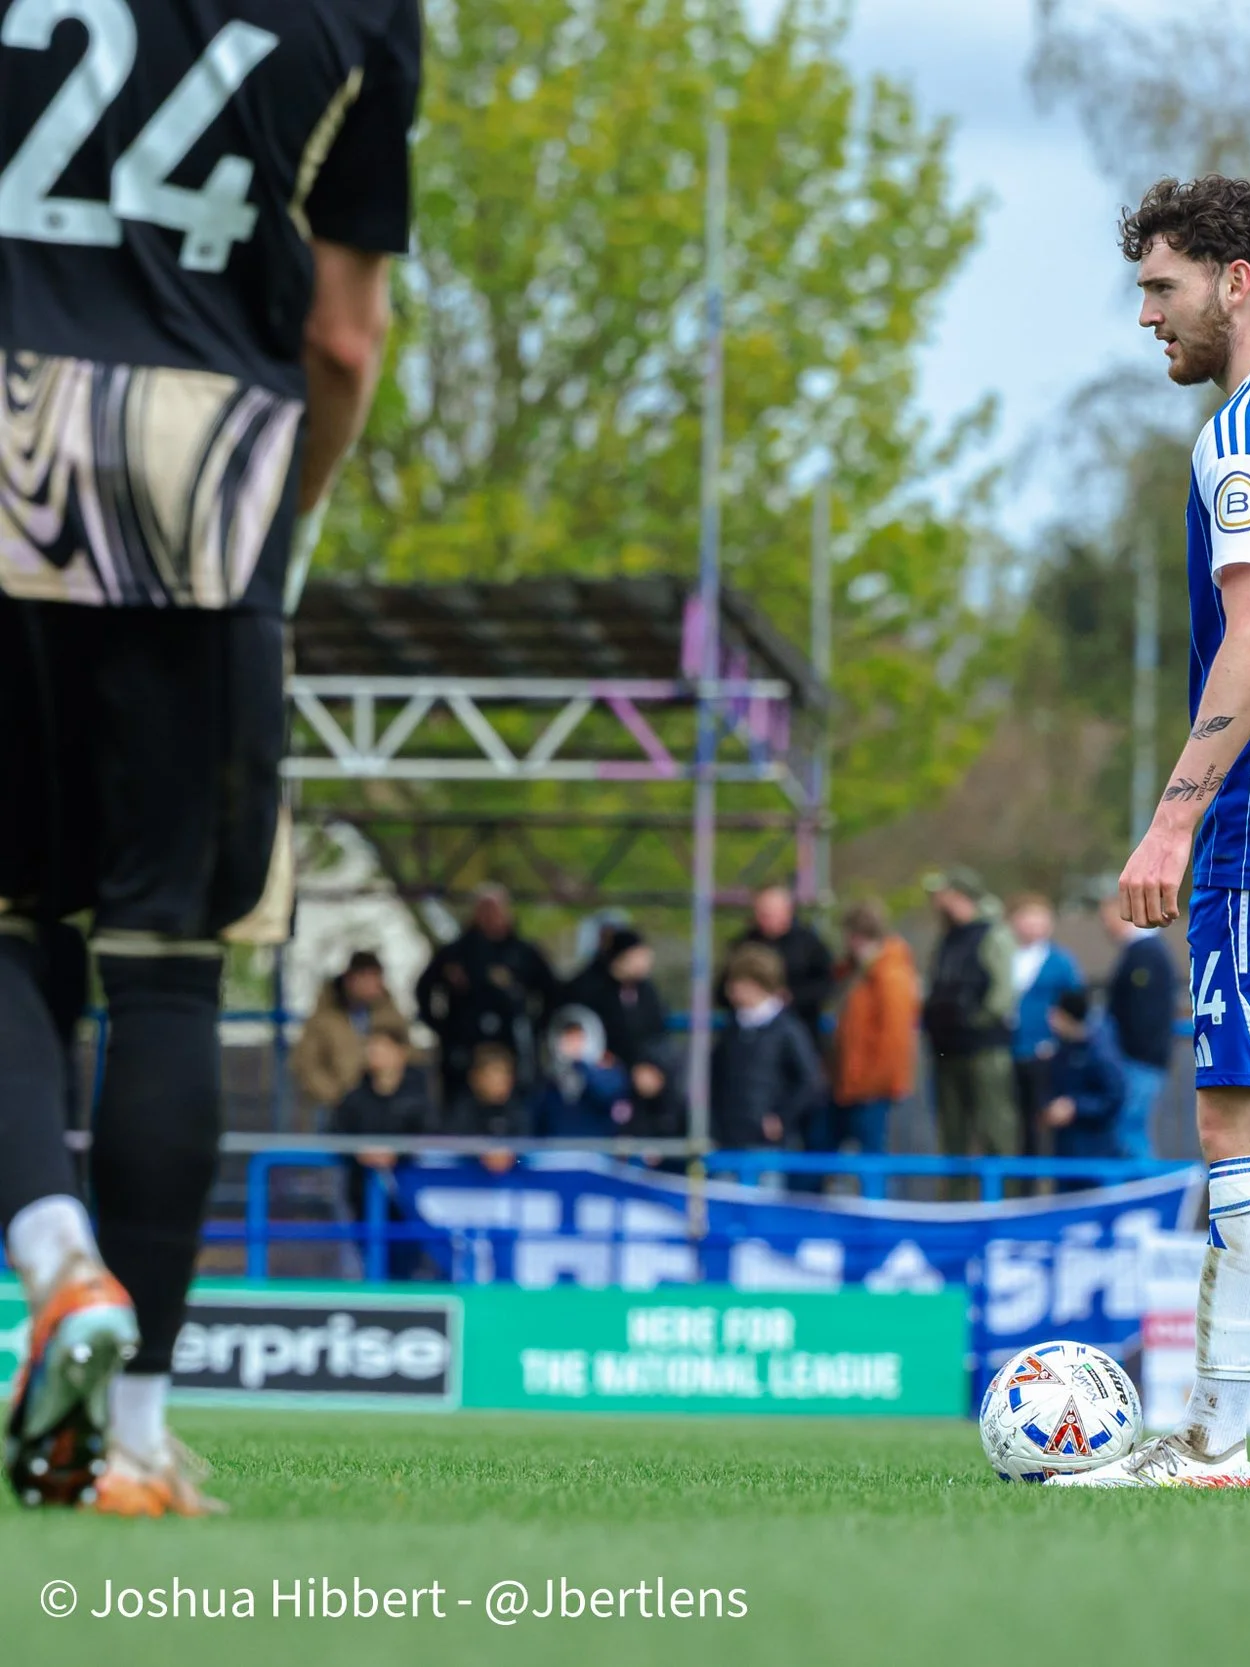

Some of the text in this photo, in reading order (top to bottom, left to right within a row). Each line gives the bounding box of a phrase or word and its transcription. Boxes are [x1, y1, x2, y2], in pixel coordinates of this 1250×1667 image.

[0, 0, 279, 273] 24
[1226, 491, 1249, 515] B
[1195, 762, 1216, 801] VISUALISE
